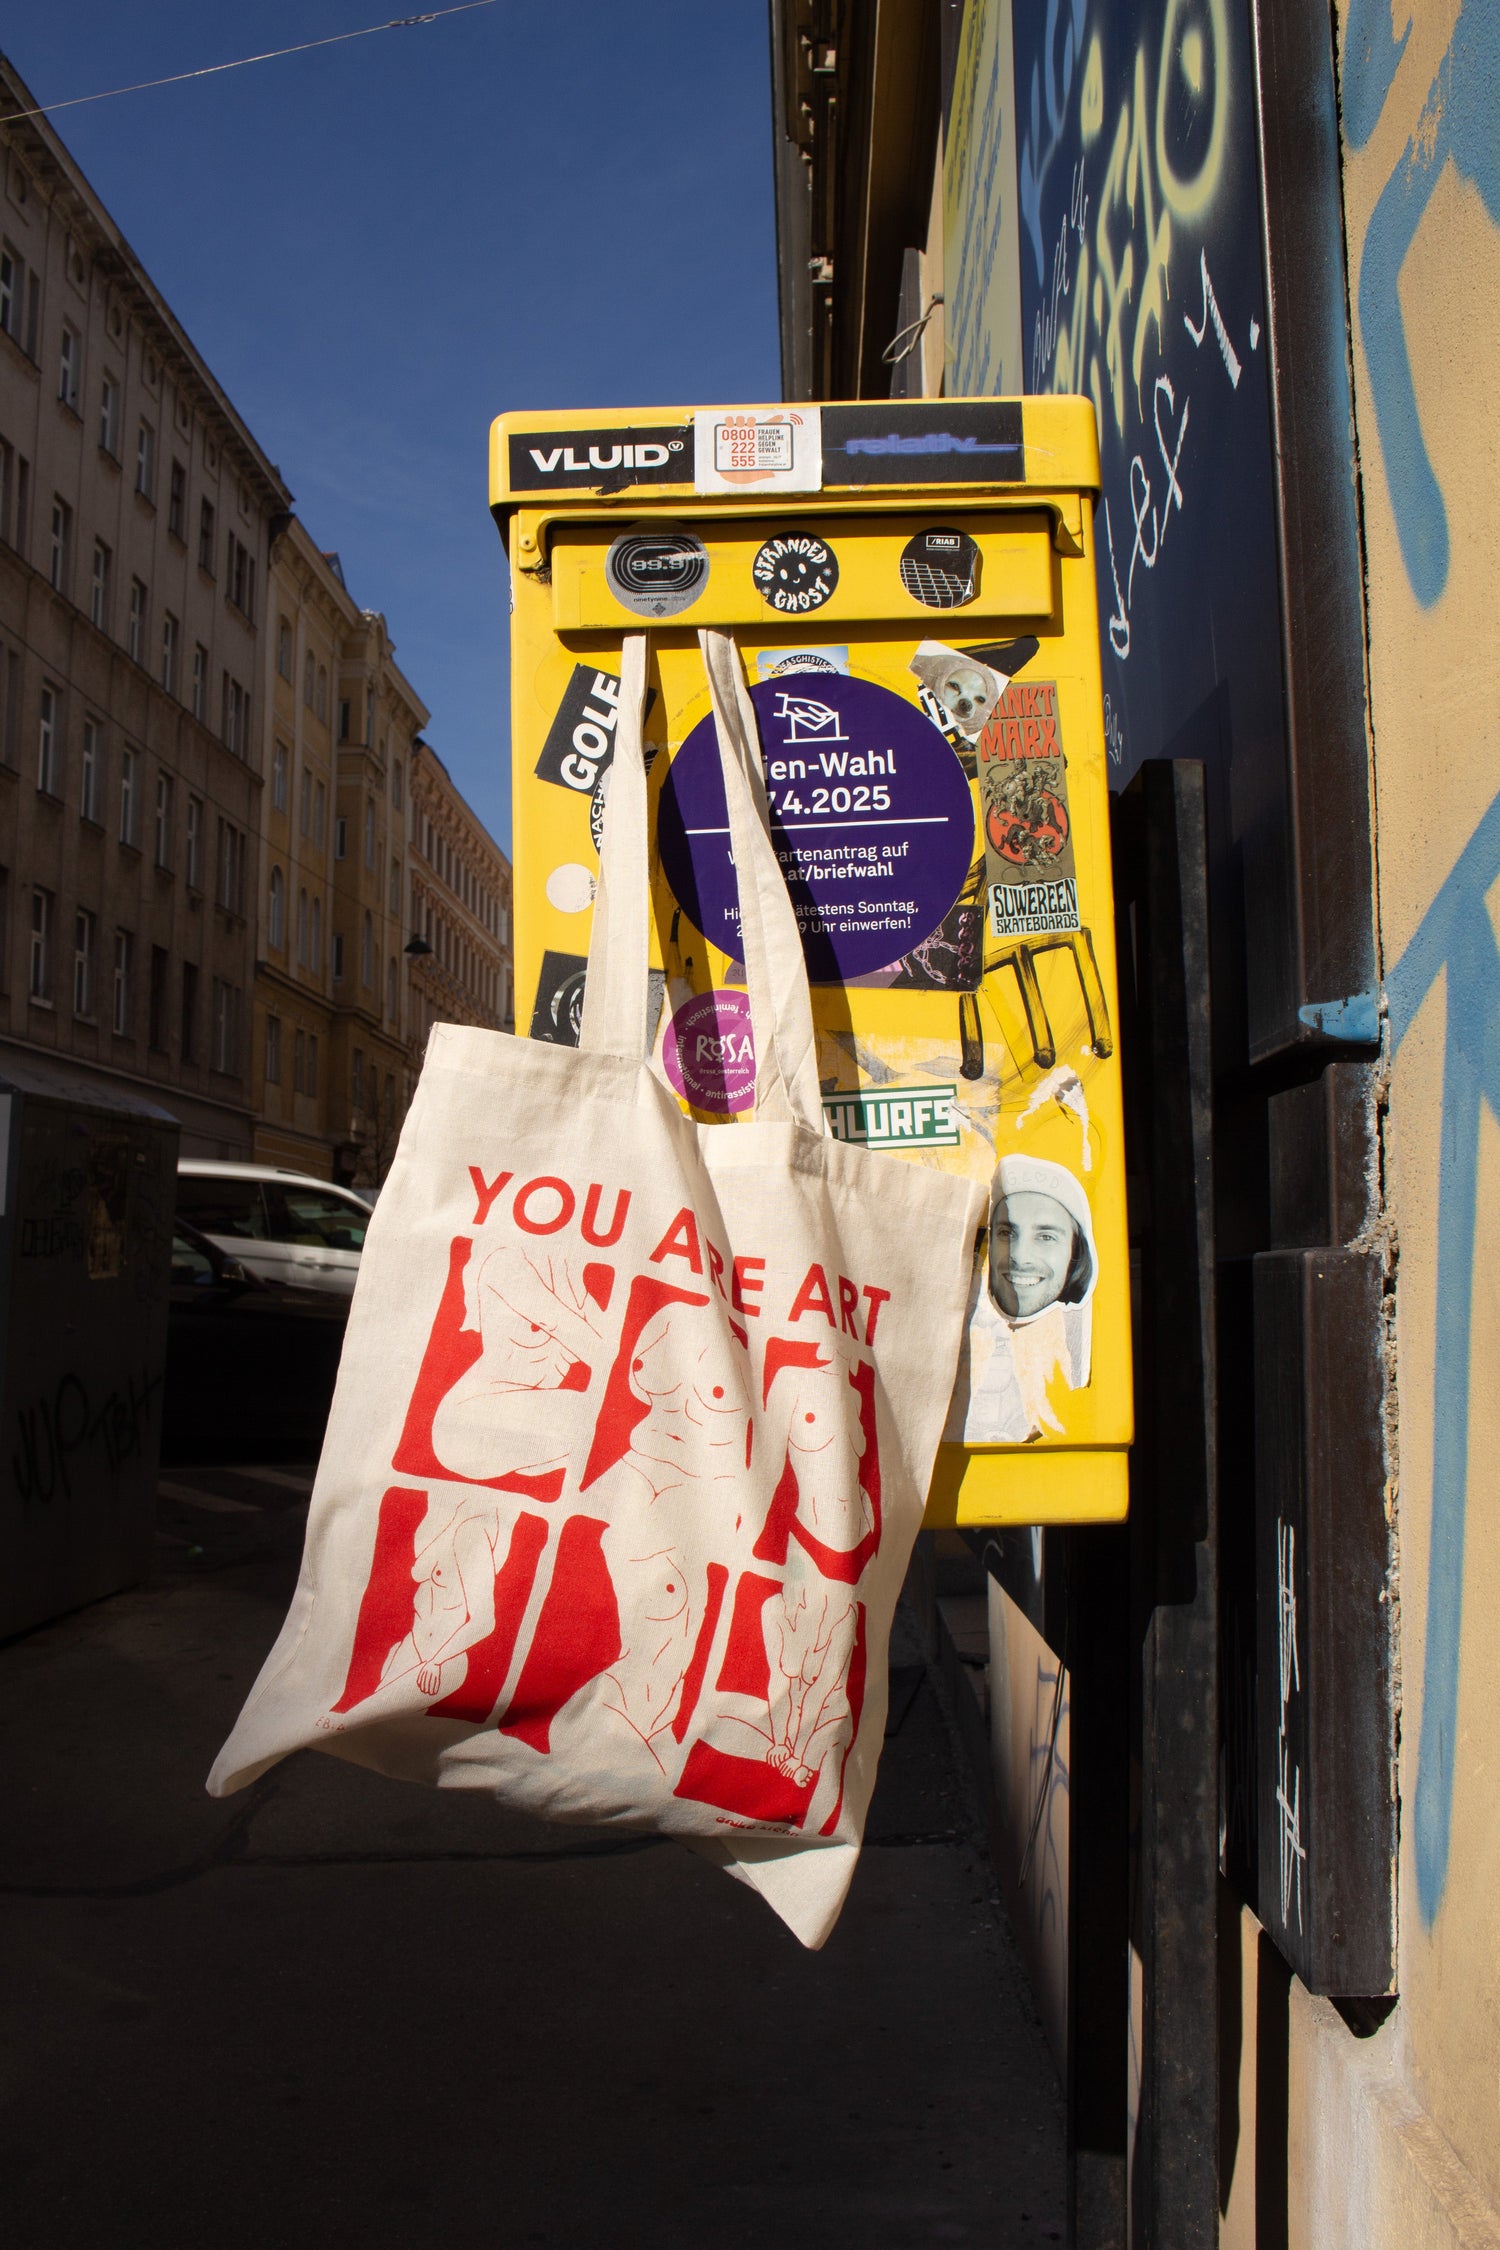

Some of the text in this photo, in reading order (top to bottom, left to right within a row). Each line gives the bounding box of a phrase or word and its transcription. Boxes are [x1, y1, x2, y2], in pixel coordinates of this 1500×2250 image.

[721, 429, 755, 440] 0800
[731, 442, 755, 453] 222
[529, 443, 670, 472] VLUID
[731, 455, 756, 467] 555
[631, 559, 684, 571] 99.9
[754, 537, 828, 581] STRANDED
[774, 576, 830, 611] GHOST
[989, 685, 1055, 719] ANKT
[981, 718, 1060, 763] MARX
[762, 749, 897, 781] ien-Wahl
[767, 785, 891, 816] 7.4.2025
[882, 842, 909, 858] auf
[794, 903, 855, 917] ätestens
[857, 901, 919, 914] Sonntag,
[993, 878, 1077, 918] SUWEREEN
[811, 920, 837, 934] Uhr
[840, 916, 912, 932] einwerfen!
[996, 913, 1079, 934] SKATEBOARDS
[823, 1099, 958, 1140] HLURFS
[468, 1165, 891, 1347] YOU ARE ART
